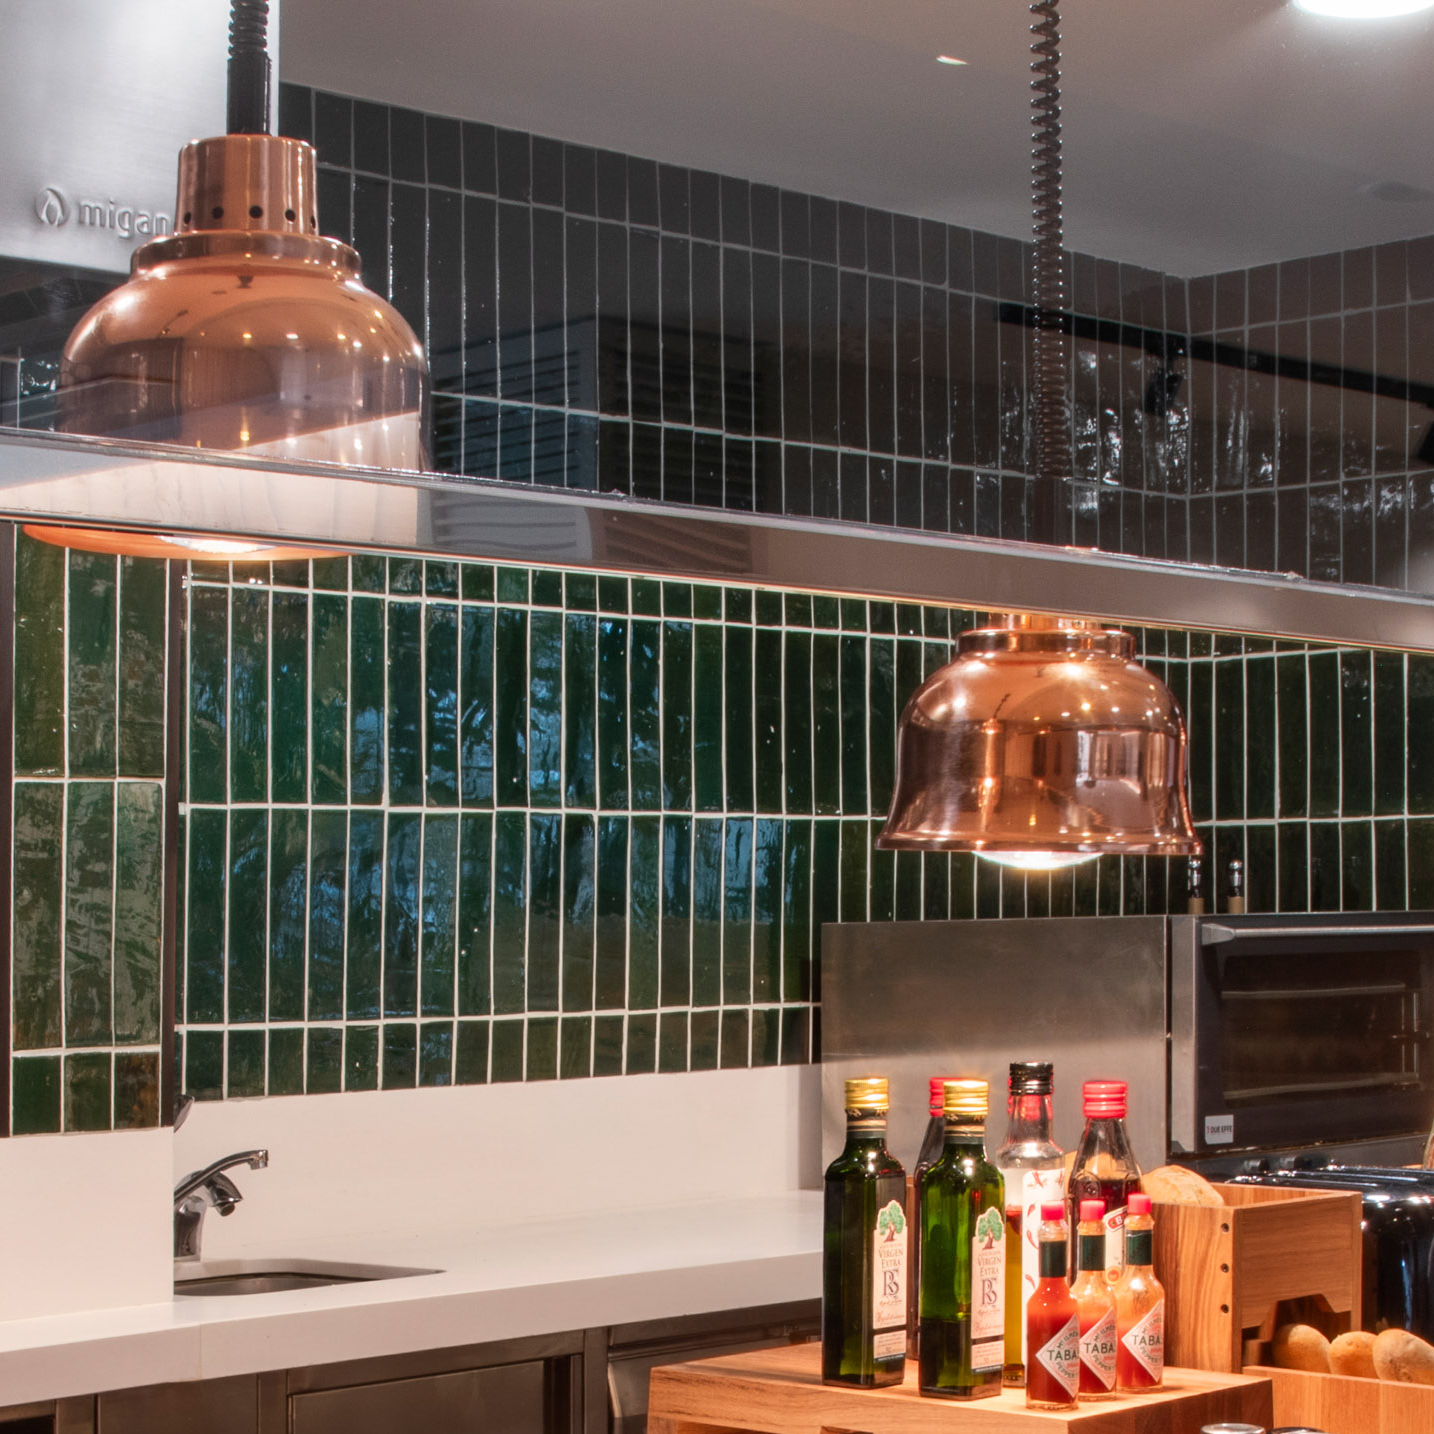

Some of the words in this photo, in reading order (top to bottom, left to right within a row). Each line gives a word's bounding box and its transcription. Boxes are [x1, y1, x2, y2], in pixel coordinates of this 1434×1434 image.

[78, 198, 170, 240] migan
[878, 1249, 903, 1258] VIRGEN
[881, 1259, 901, 1269] EXTRA
[977, 1256, 1001, 1266] VIRGEN
[980, 1266, 999, 1277] EXTRA
[1132, 1335, 1162, 1346] TABA
[1084, 1343, 1116, 1354] TABA
[1047, 1349, 1079, 1360] TABA
